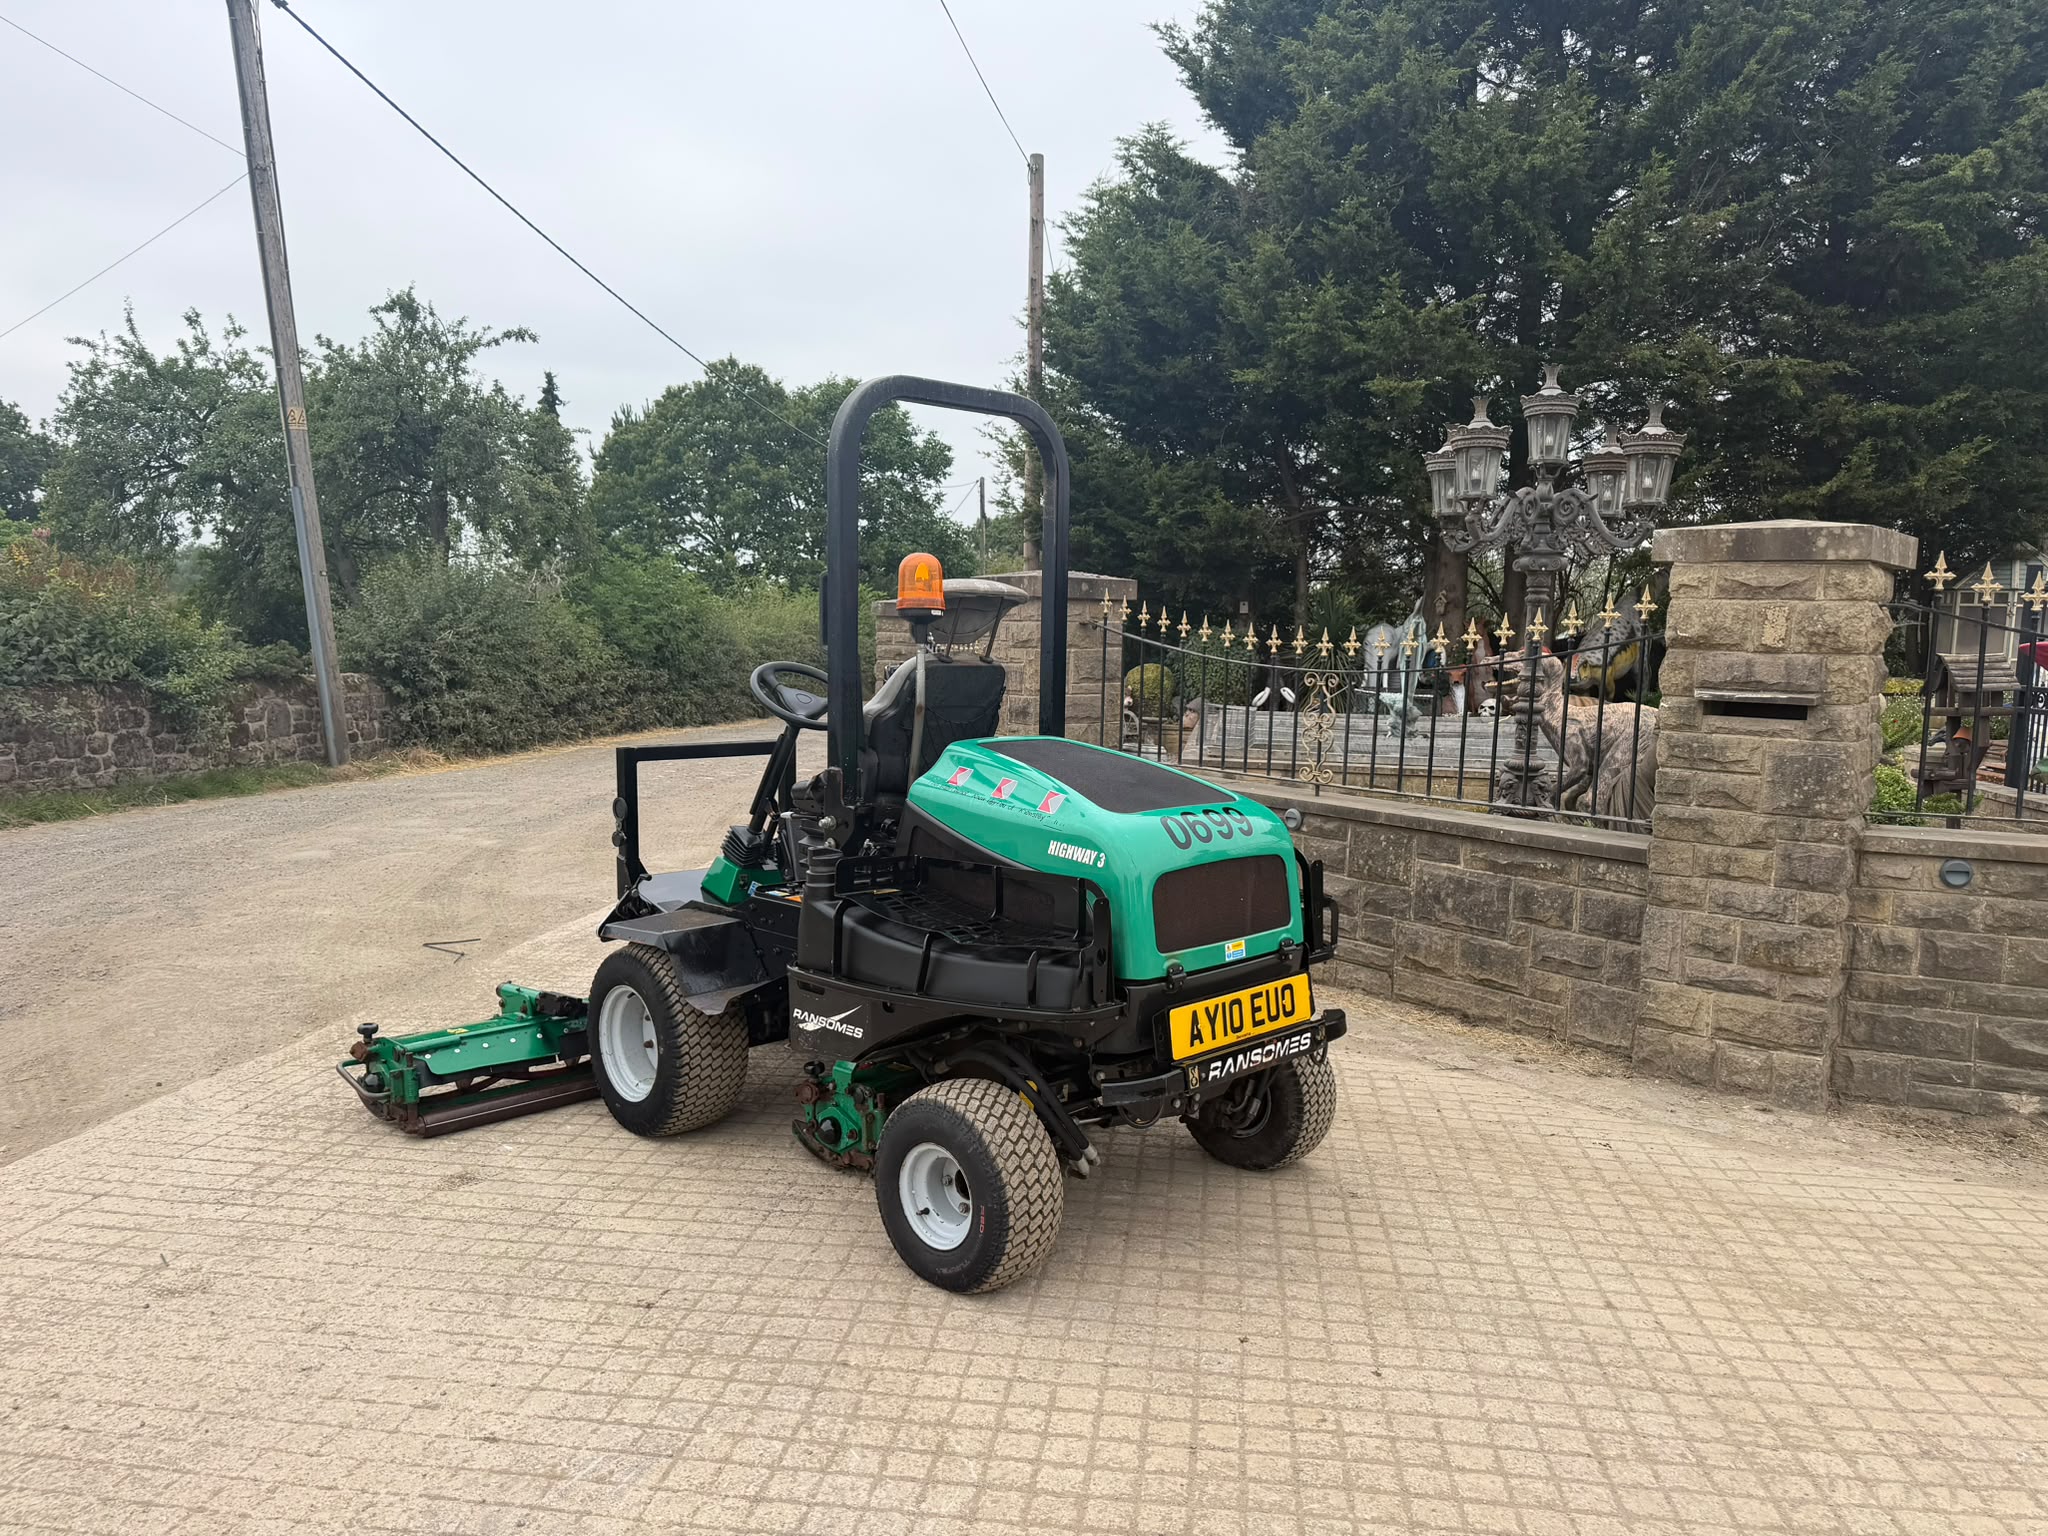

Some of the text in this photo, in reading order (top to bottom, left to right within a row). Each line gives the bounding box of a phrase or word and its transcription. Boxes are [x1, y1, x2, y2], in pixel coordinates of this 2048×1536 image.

[1160, 807, 1253, 850] 0699
[1047, 839, 1106, 868] HIGHWAY 3
[792, 1008, 864, 1039] RANSOMES
[1190, 983, 1295, 1048] AY10 EUO
[1208, 1032, 1312, 1082] RANSOMES
